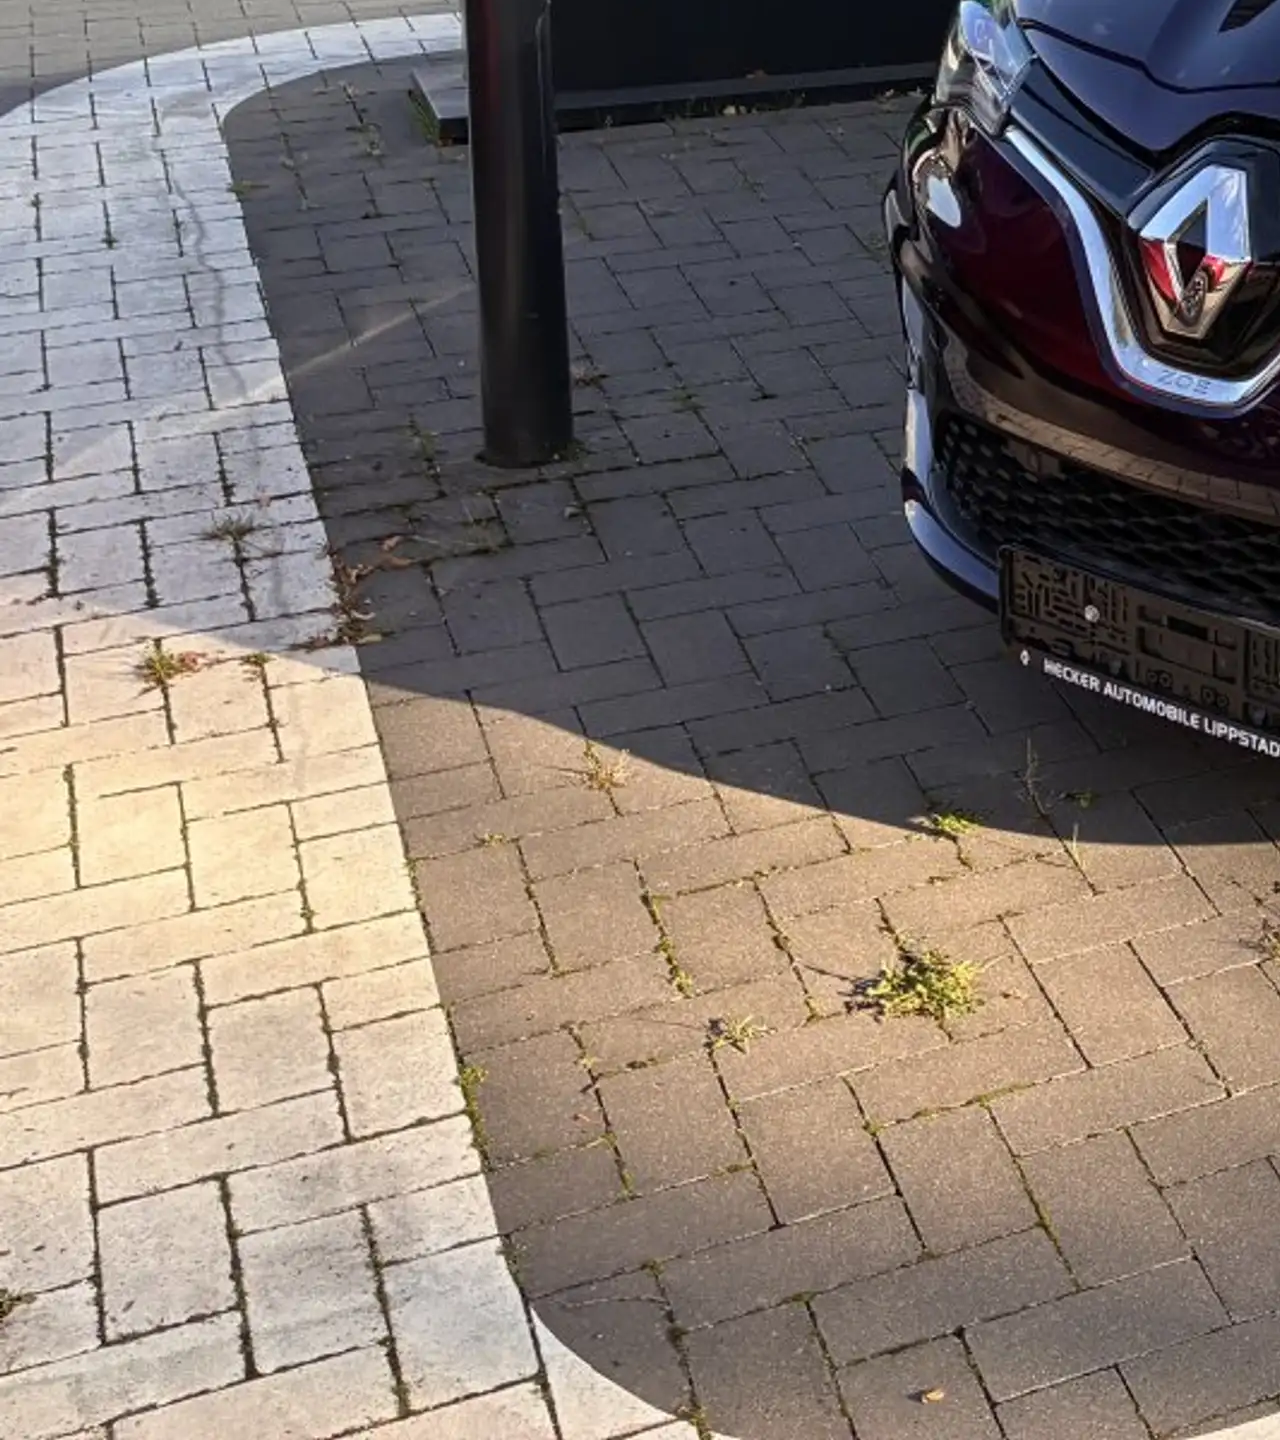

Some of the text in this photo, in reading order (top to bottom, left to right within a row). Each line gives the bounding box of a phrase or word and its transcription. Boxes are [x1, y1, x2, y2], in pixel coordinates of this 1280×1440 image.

[1158, 370, 1211, 395] ZOE
[1044, 658, 1101, 692] HECKER
[1103, 681, 1202, 730] AUTOMOBILE
